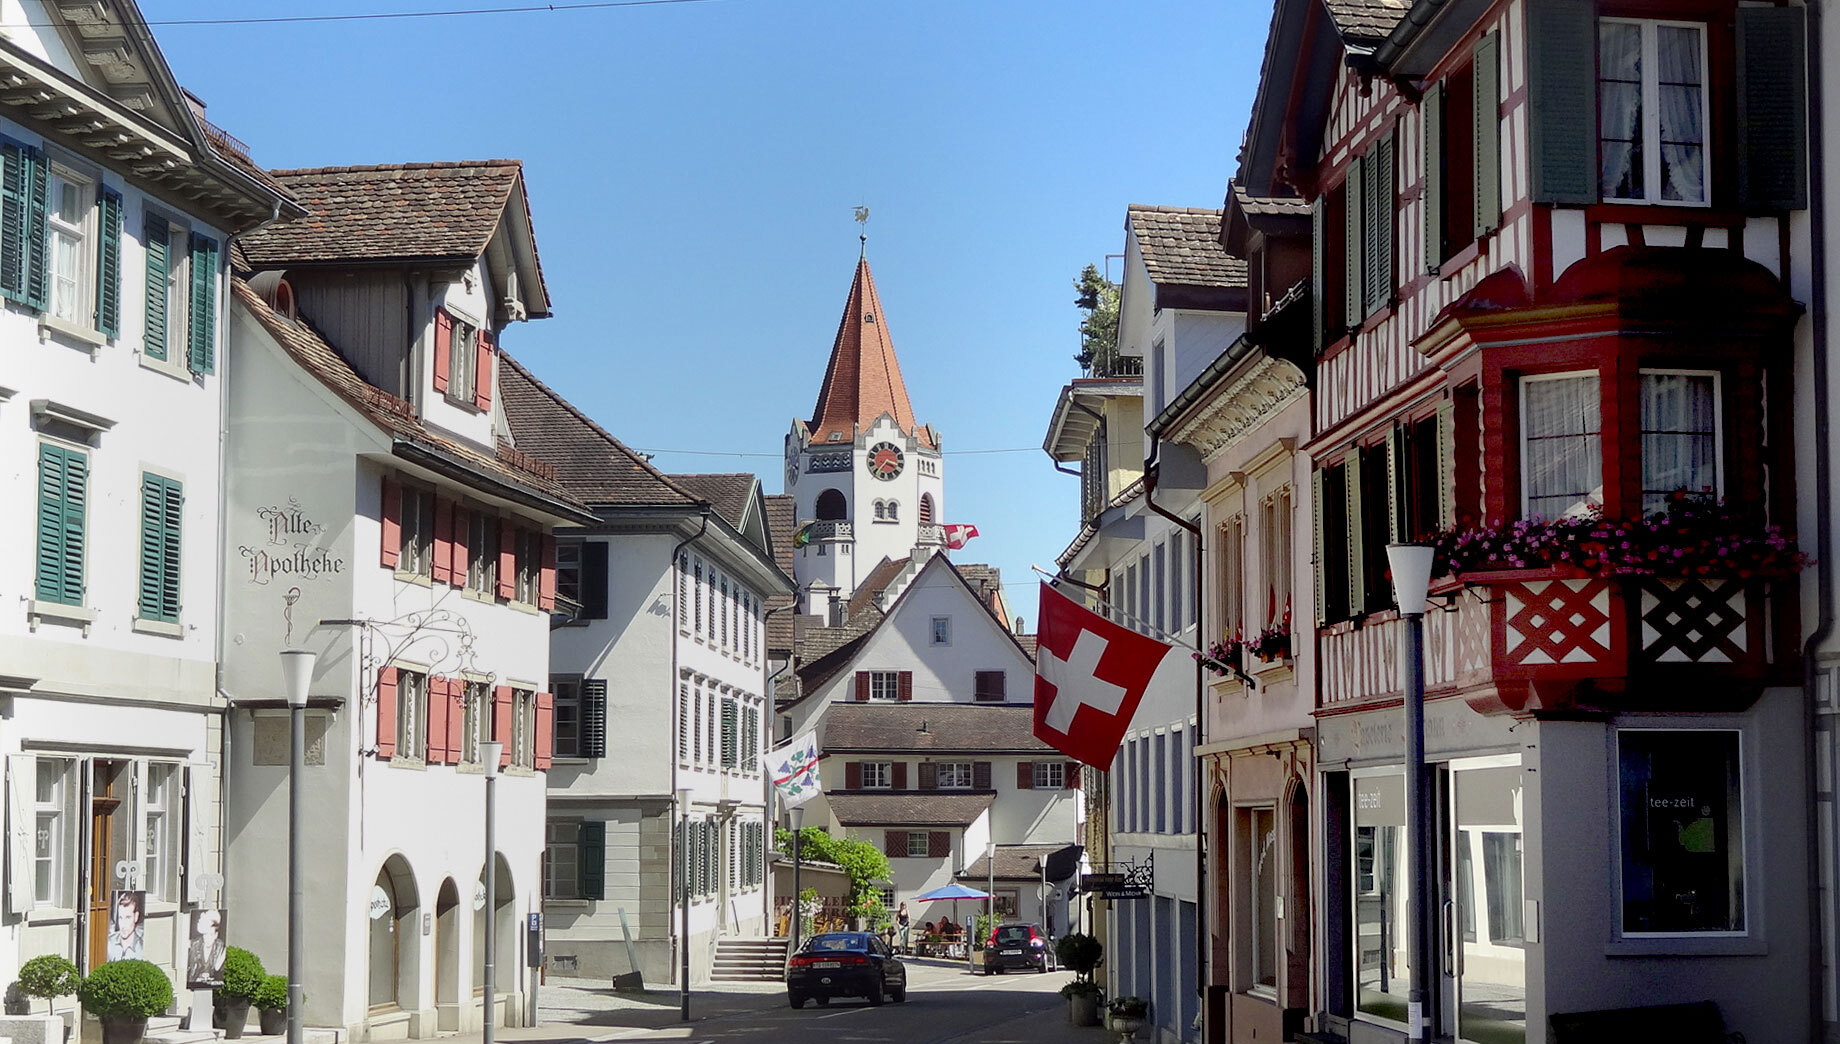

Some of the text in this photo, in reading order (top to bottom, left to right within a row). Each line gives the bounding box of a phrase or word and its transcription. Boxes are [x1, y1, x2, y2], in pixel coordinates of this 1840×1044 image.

[259, 505, 322, 545] Alte
[239, 543, 345, 585] Apotheke
[1358, 786, 1381, 809] tee-zeit
[1650, 797, 1695, 808] tee-zeit
